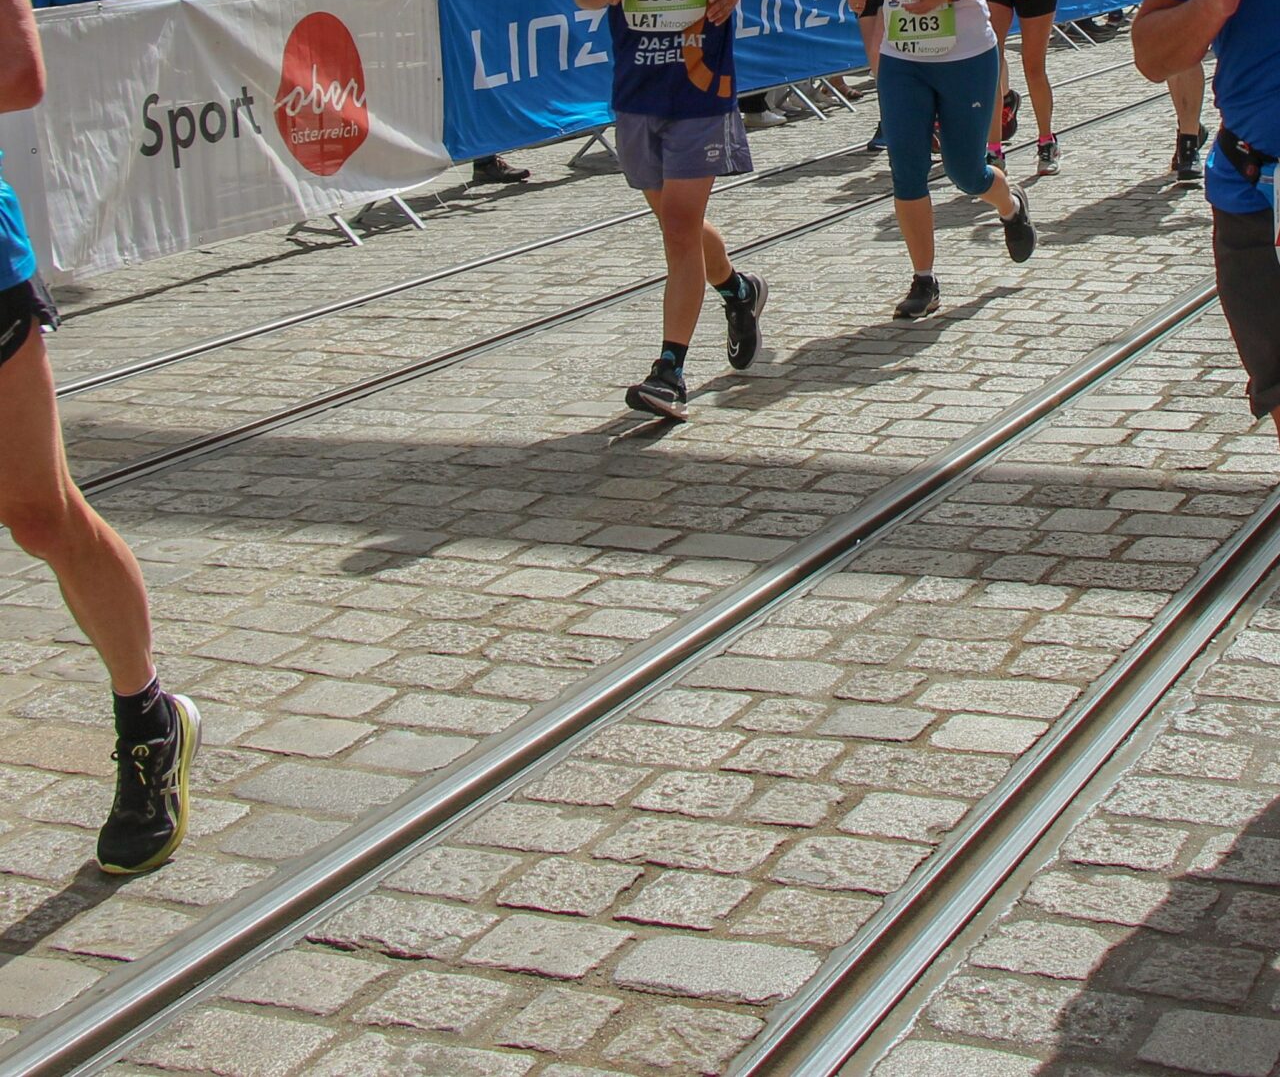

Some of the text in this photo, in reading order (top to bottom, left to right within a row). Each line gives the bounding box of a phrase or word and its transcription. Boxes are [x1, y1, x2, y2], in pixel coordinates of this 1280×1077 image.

[632, 13, 691, 29] LAT Nitrog
[898, 16, 940, 32] 2163
[471, 9, 609, 91] LINZ
[638, 33, 706, 50] DAS HAT
[634, 49, 685, 65] STEEL
[140, 86, 262, 168] Sport
[290, 121, 359, 145] österreich
